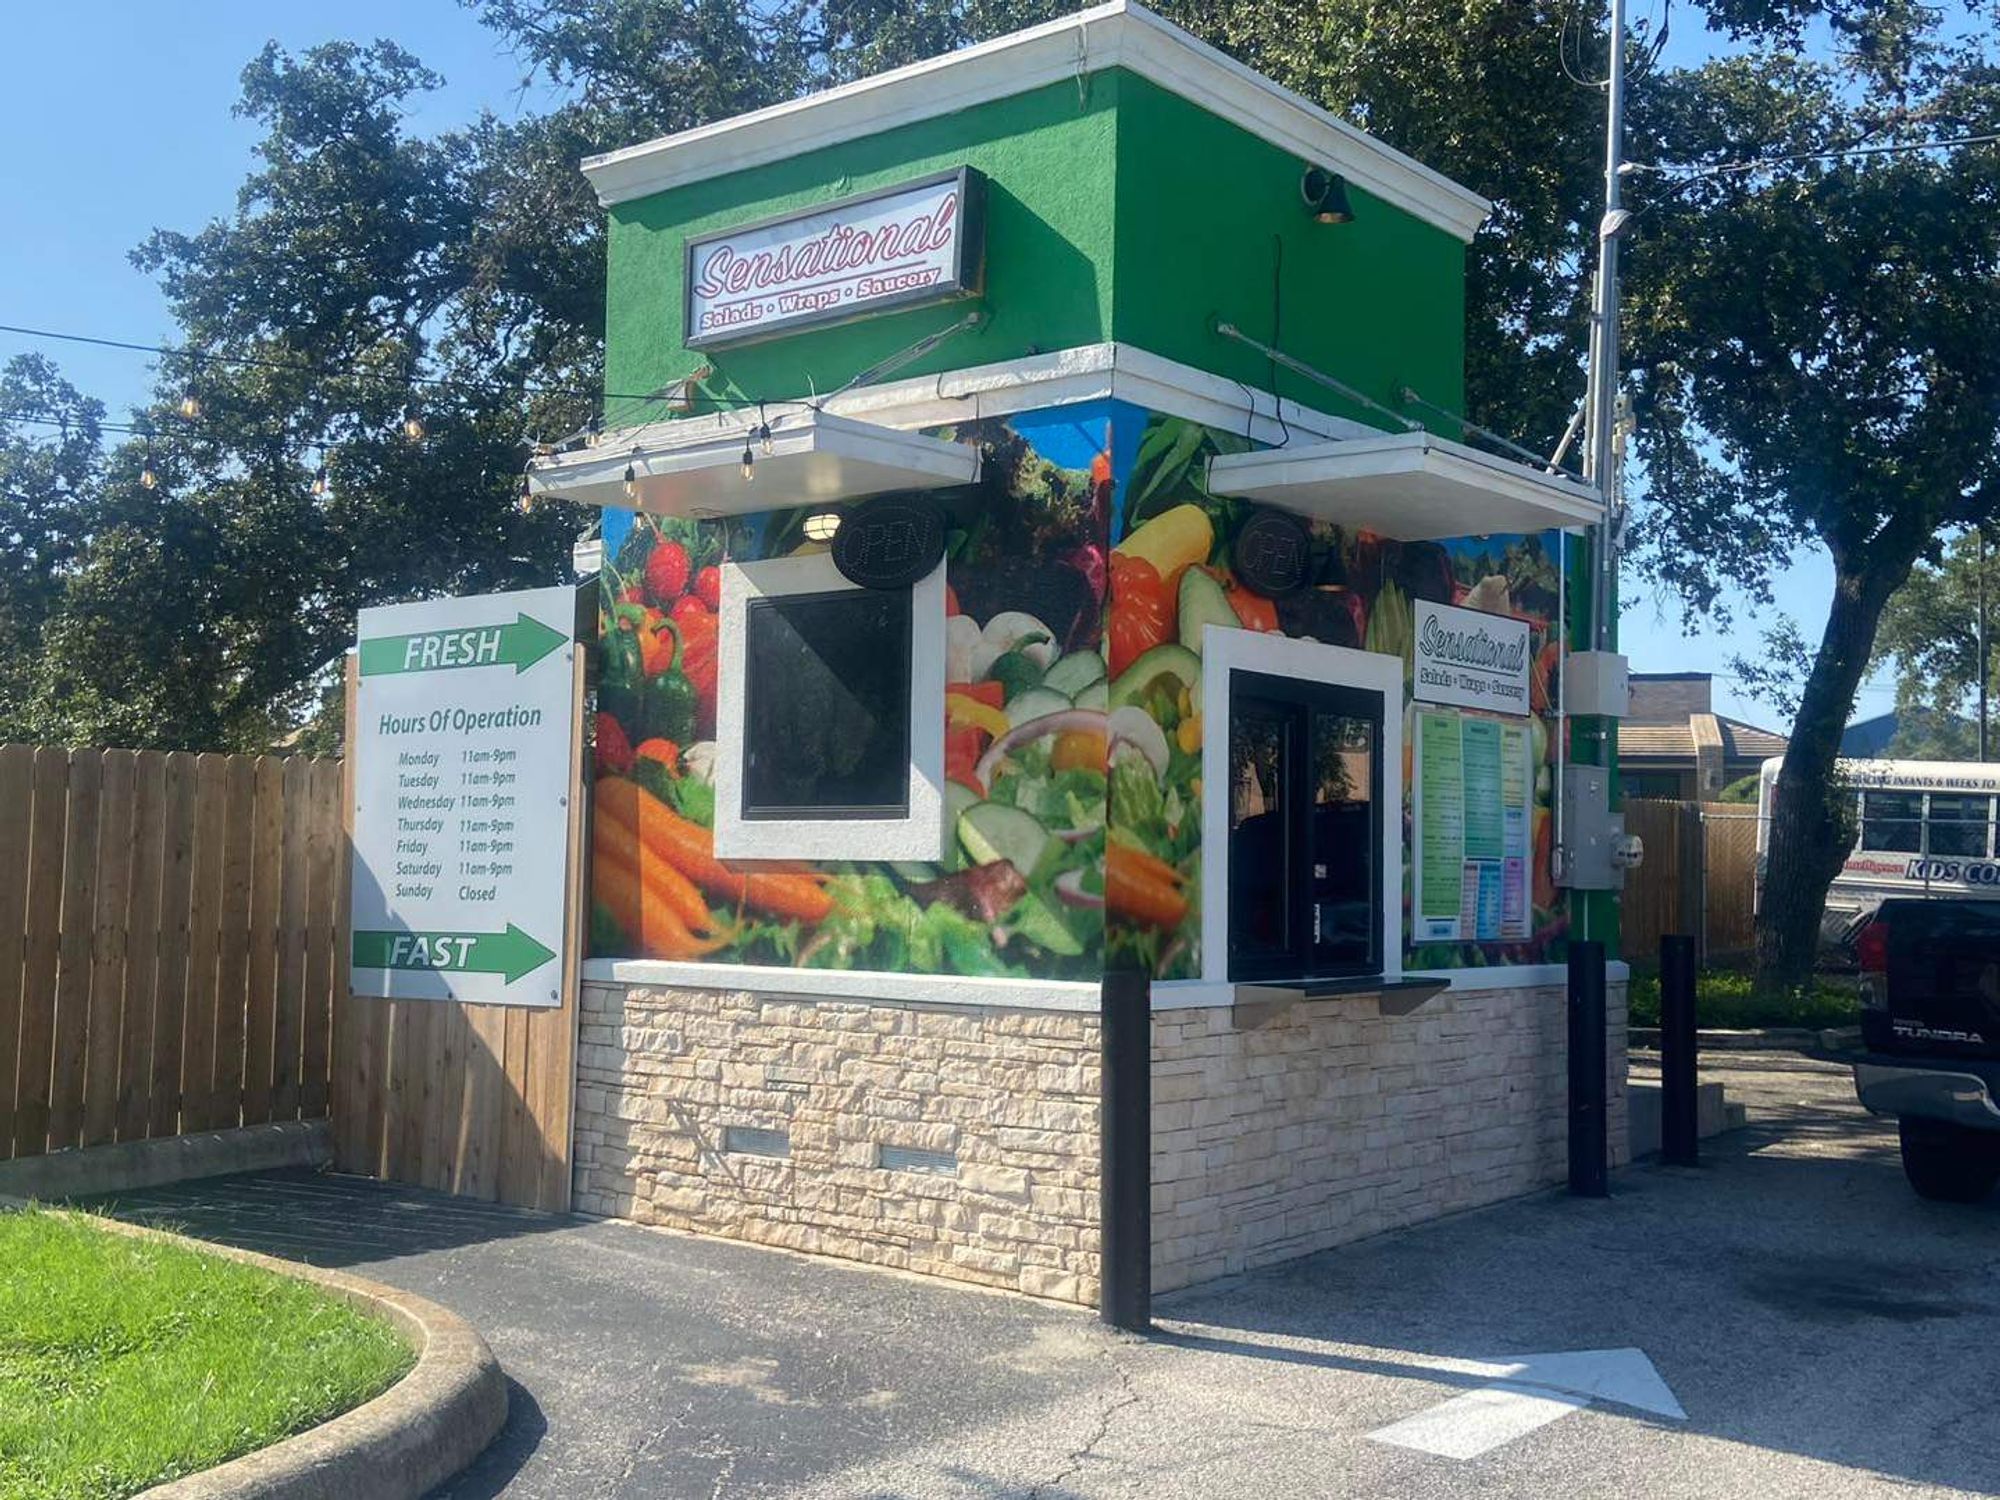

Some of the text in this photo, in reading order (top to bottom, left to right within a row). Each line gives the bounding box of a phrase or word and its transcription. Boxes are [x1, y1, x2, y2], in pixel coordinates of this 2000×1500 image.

[695, 192, 957, 298] Sensational
[701, 267, 941, 329] Salads Wraps Saucery
[404, 629, 501, 670] FRESH
[379, 704, 542, 735] Hours Of Operation
[399, 748, 517, 768] Monday 11am-9pm
[399, 771, 516, 790] Tuesday 11am-9pm
[1893, 776, 1935, 787] INFANTS
[1946, 778, 1978, 788] WEEKS
[1982, 779, 1996, 789] TO
[398, 794, 515, 812] Wednesday 11am-9pm
[398, 818, 514, 834] Thursday 11am-9pm
[396, 839, 513, 856] Friday 11am-9pm
[396, 861, 513, 878] Saturday 11am-9pm
[1906, 859, 2000, 885] KIDS CO
[395, 882, 497, 901] Sunday Closed
[390, 936, 477, 968] FAST
[1893, 1026, 1985, 1043] TUNDRA
